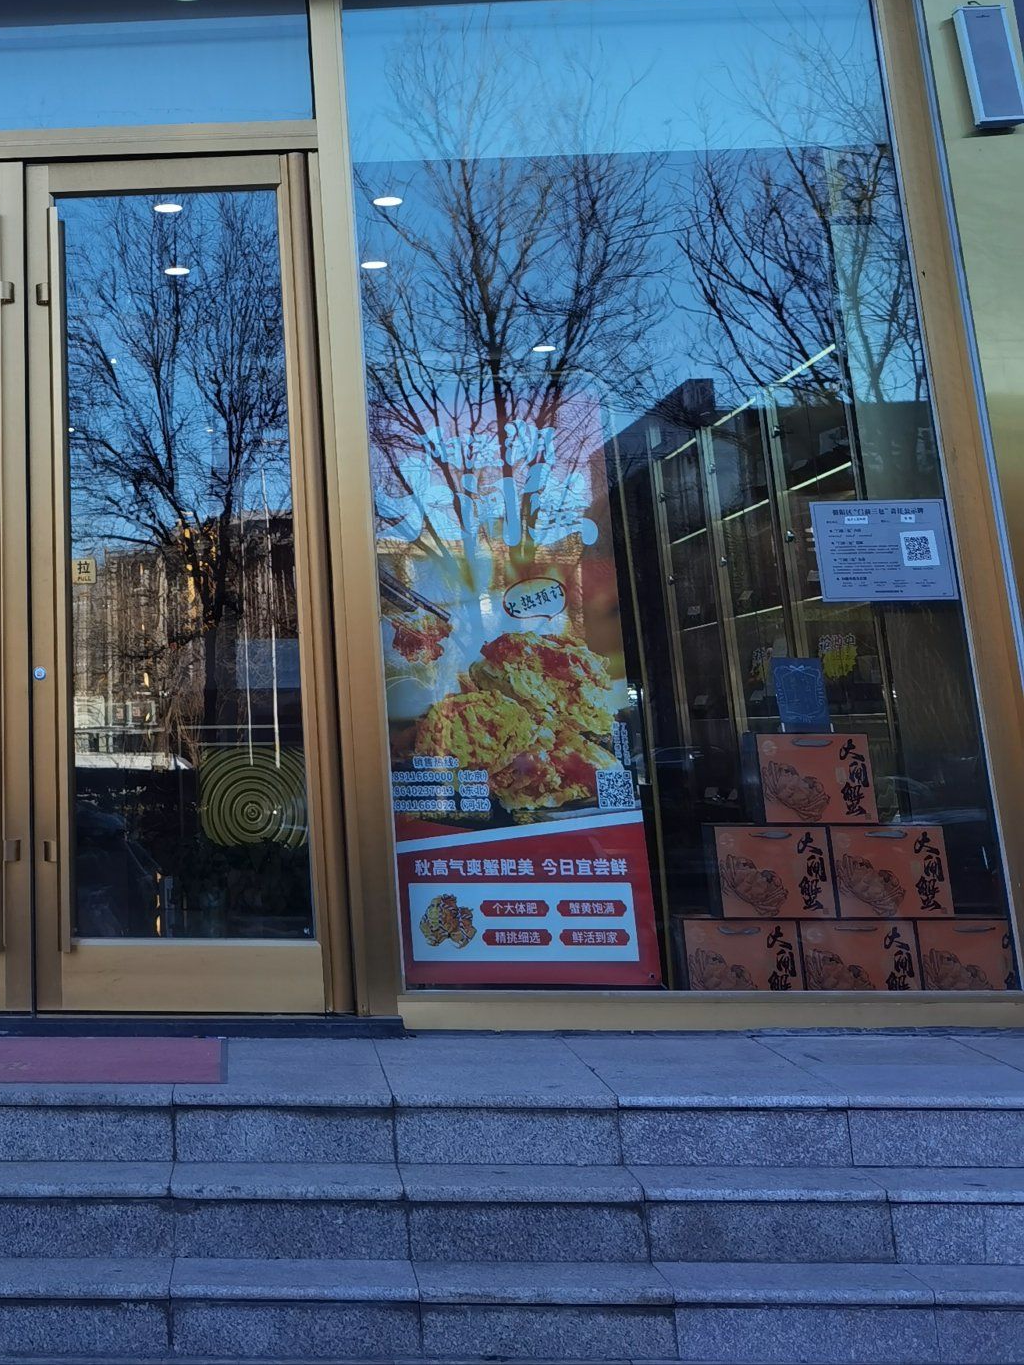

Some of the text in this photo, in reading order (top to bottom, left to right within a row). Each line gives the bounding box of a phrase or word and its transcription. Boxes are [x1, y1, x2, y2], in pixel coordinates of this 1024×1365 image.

[77, 561, 90, 574] 拉
[507, 583, 565, 617] 火热预订
[392, 771, 453, 782] 8911669000
[393, 786, 455, 796] 8640237013
[394, 800, 456, 811] 8911669022
[414, 858, 628, 876] 秋高气爽蟹肥美 今日宜尝鲜
[492, 903, 538, 914] 个大体肥
[569, 903, 615, 914] 蟹黄饱满
[495, 932, 541, 944] 精挑细选
[572, 931, 618, 943] 鲜活到家
